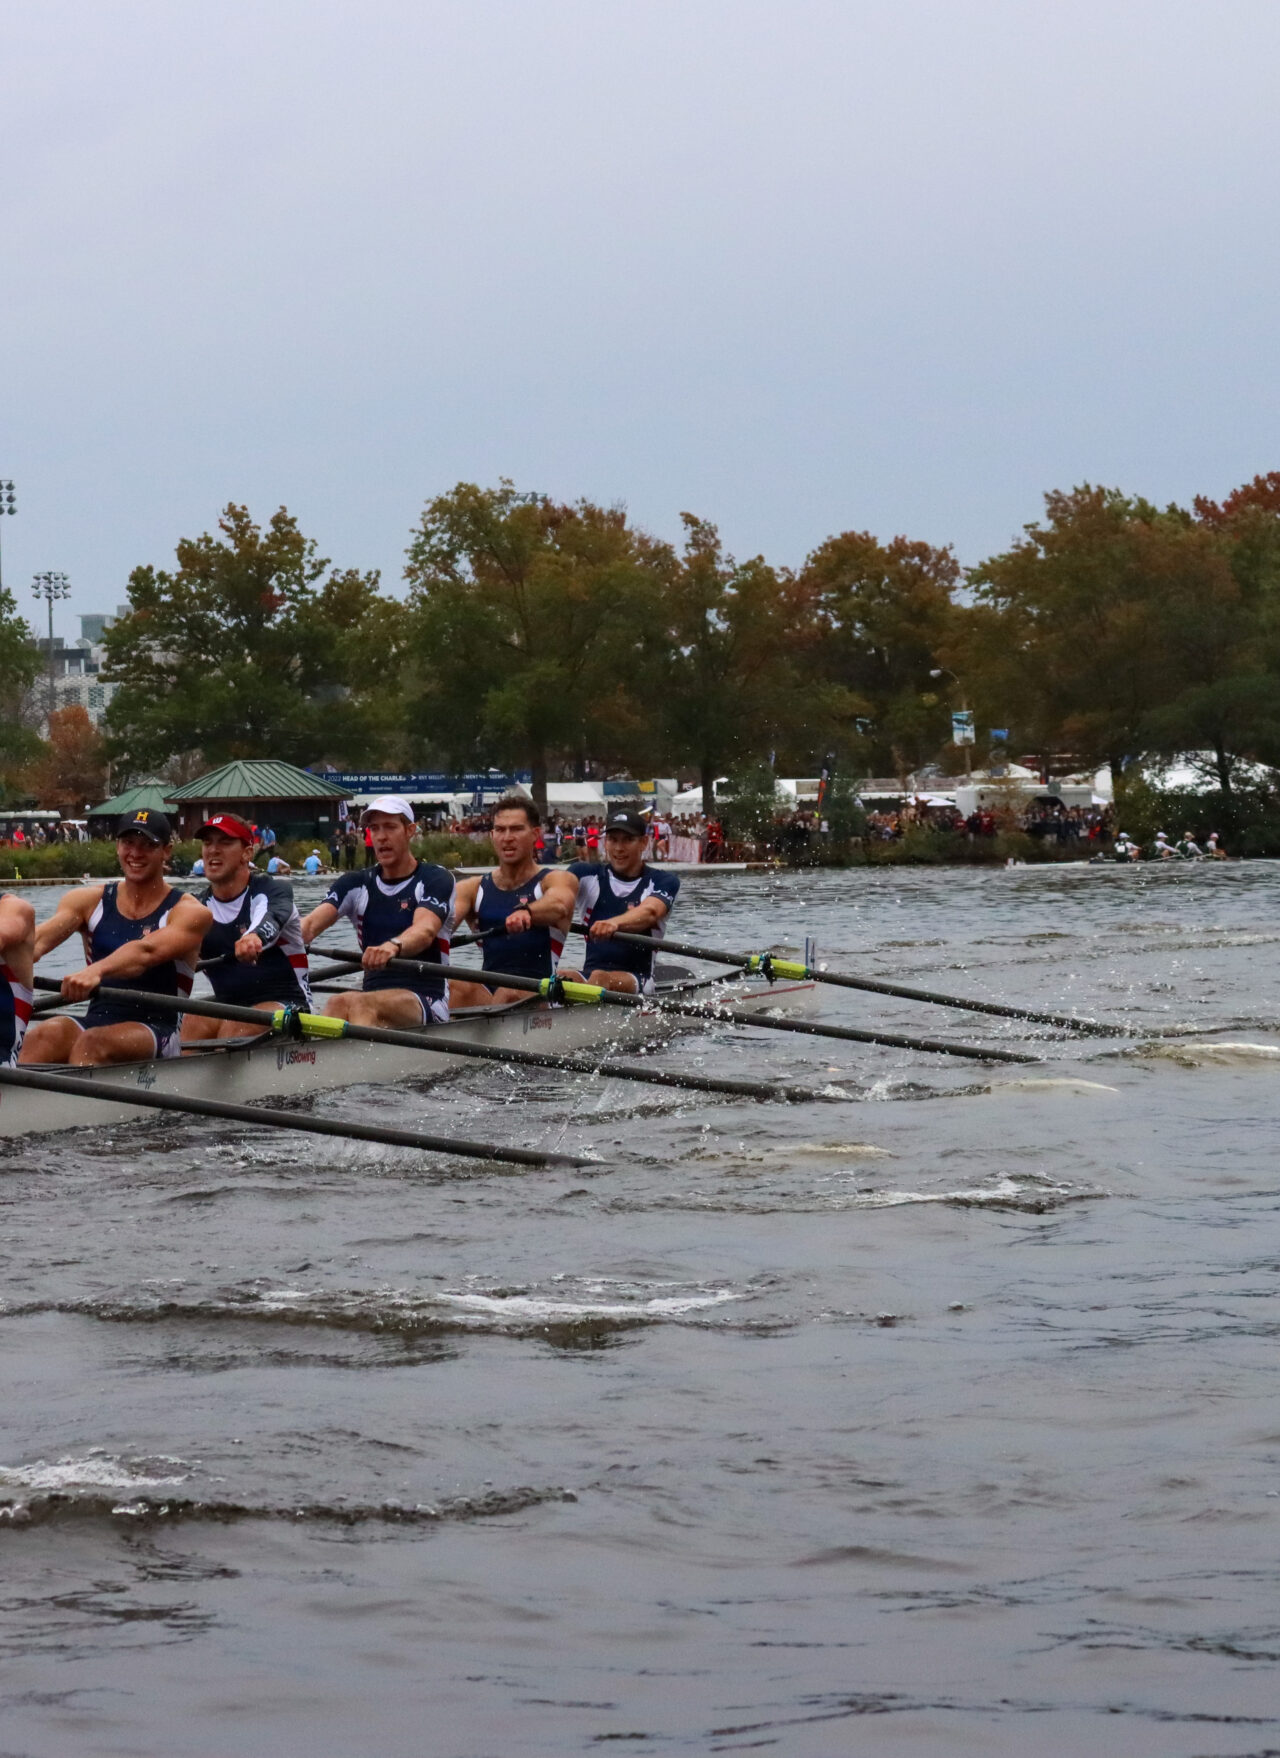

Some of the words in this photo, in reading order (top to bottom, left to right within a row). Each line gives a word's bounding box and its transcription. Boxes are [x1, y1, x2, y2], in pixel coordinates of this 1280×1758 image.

[135, 811, 149, 821] H
[212, 816, 223, 825] W
[420, 896, 448, 914] USA
[259, 920, 278, 939] USA
[286, 1050, 316, 1066] USRowing
